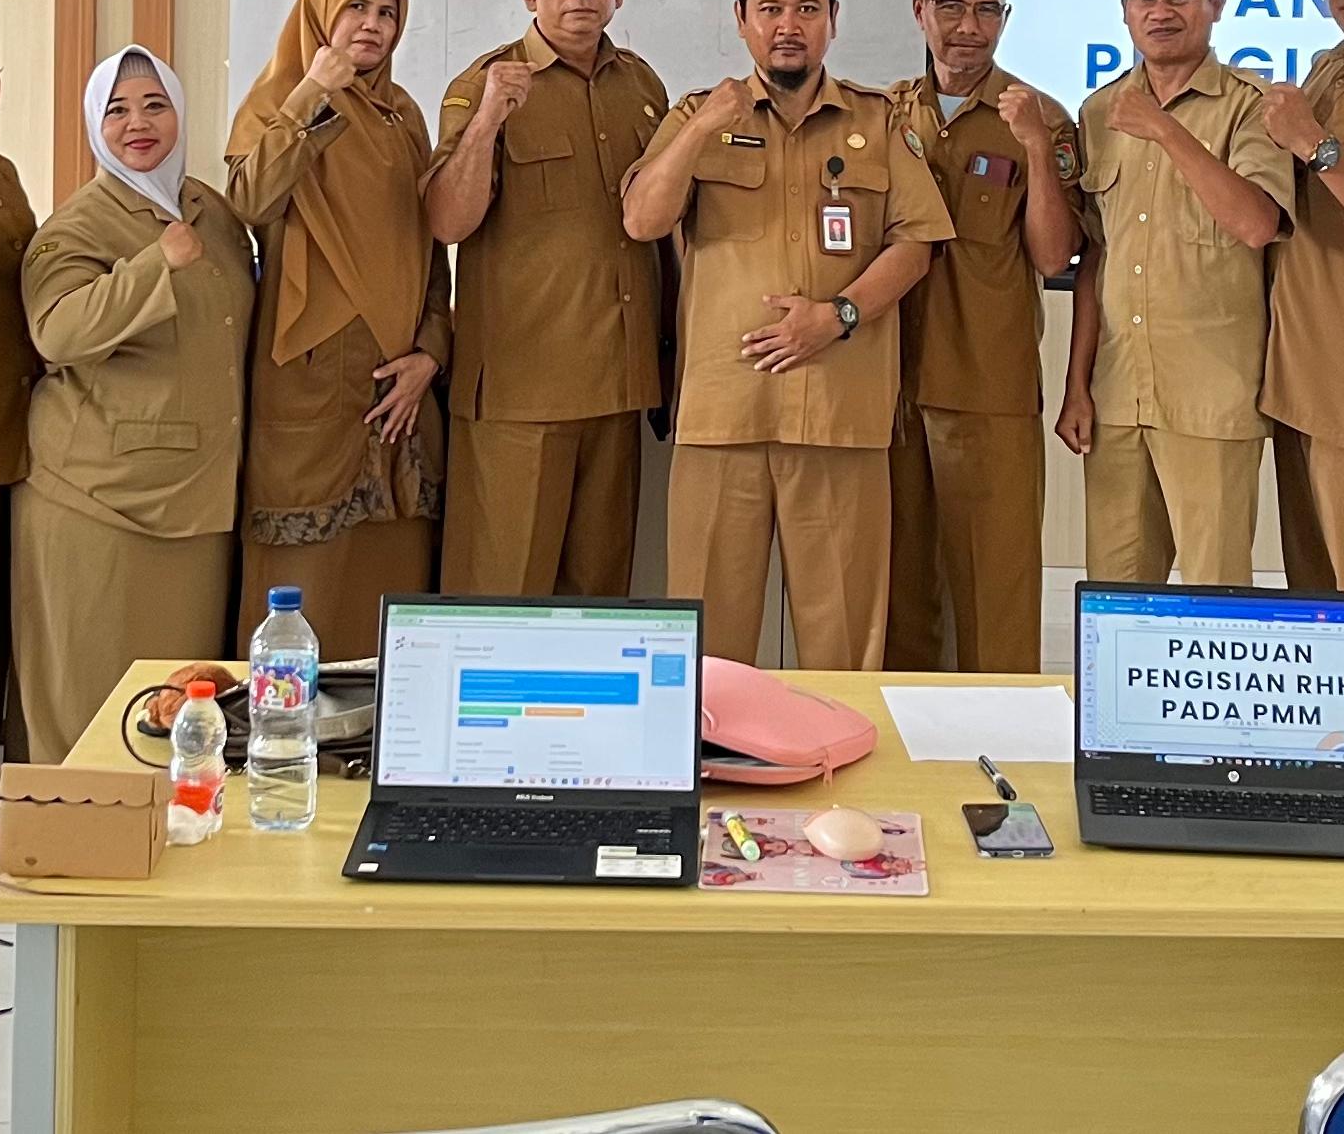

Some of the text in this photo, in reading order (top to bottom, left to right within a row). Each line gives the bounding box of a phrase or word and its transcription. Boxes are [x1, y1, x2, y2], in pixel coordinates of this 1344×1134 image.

[1168, 638, 1312, 664] PANDUAN
[1128, 667, 1285, 694] PENGISIAN
[1162, 699, 1321, 726] PADA PMM
